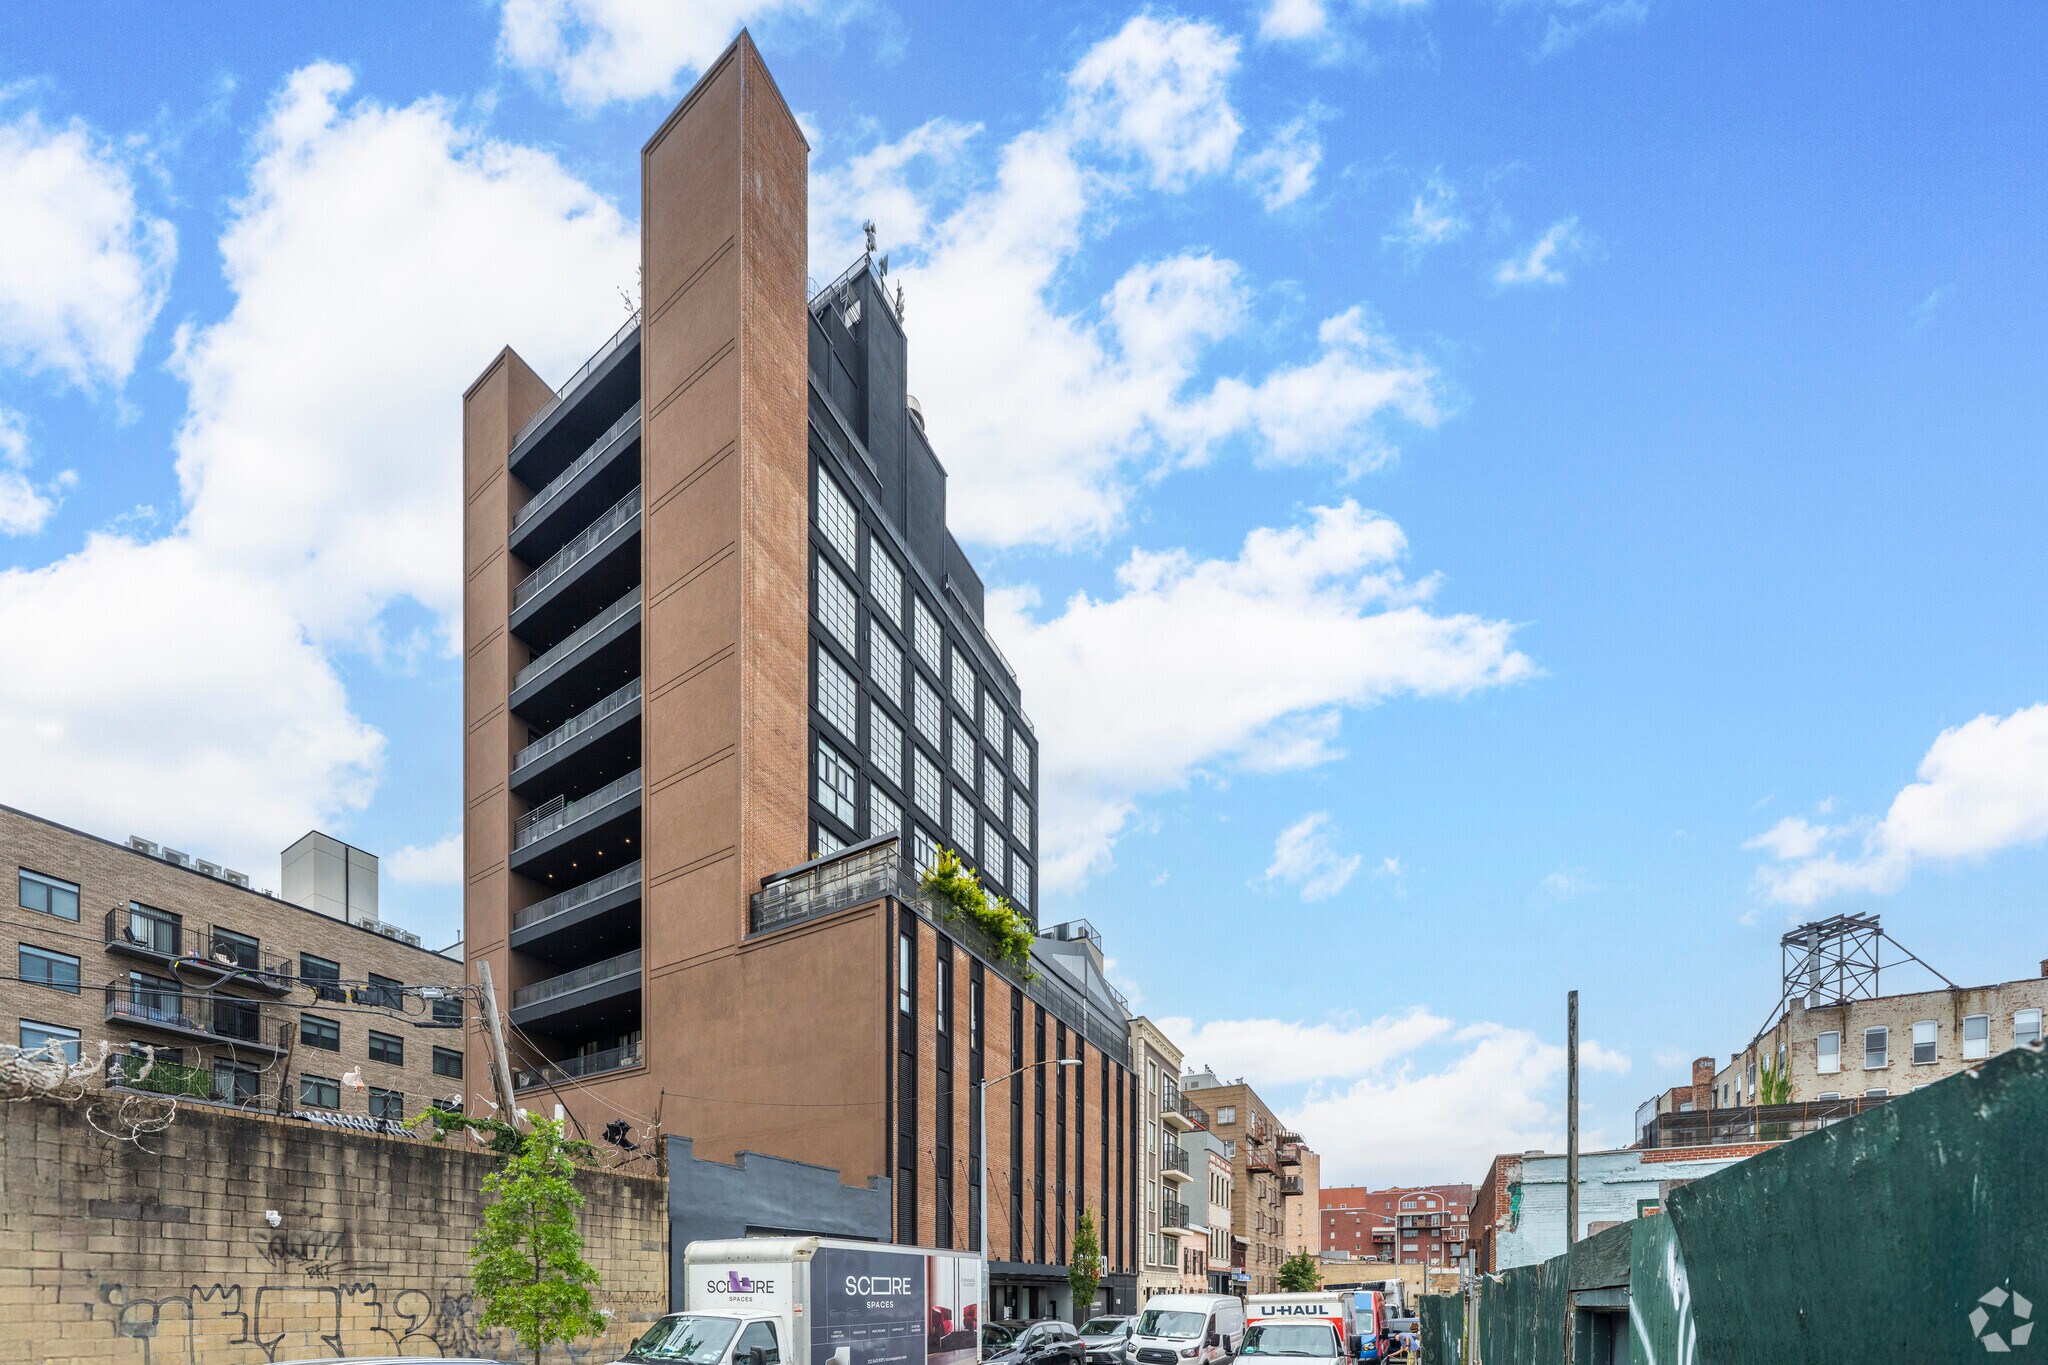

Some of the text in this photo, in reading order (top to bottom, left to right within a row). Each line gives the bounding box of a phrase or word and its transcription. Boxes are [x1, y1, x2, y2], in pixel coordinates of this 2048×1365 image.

[845, 1275, 912, 1296] SCORE
[866, 1300, 894, 1309] SPACES
[1261, 1305, 1329, 1315] U-HAUL
